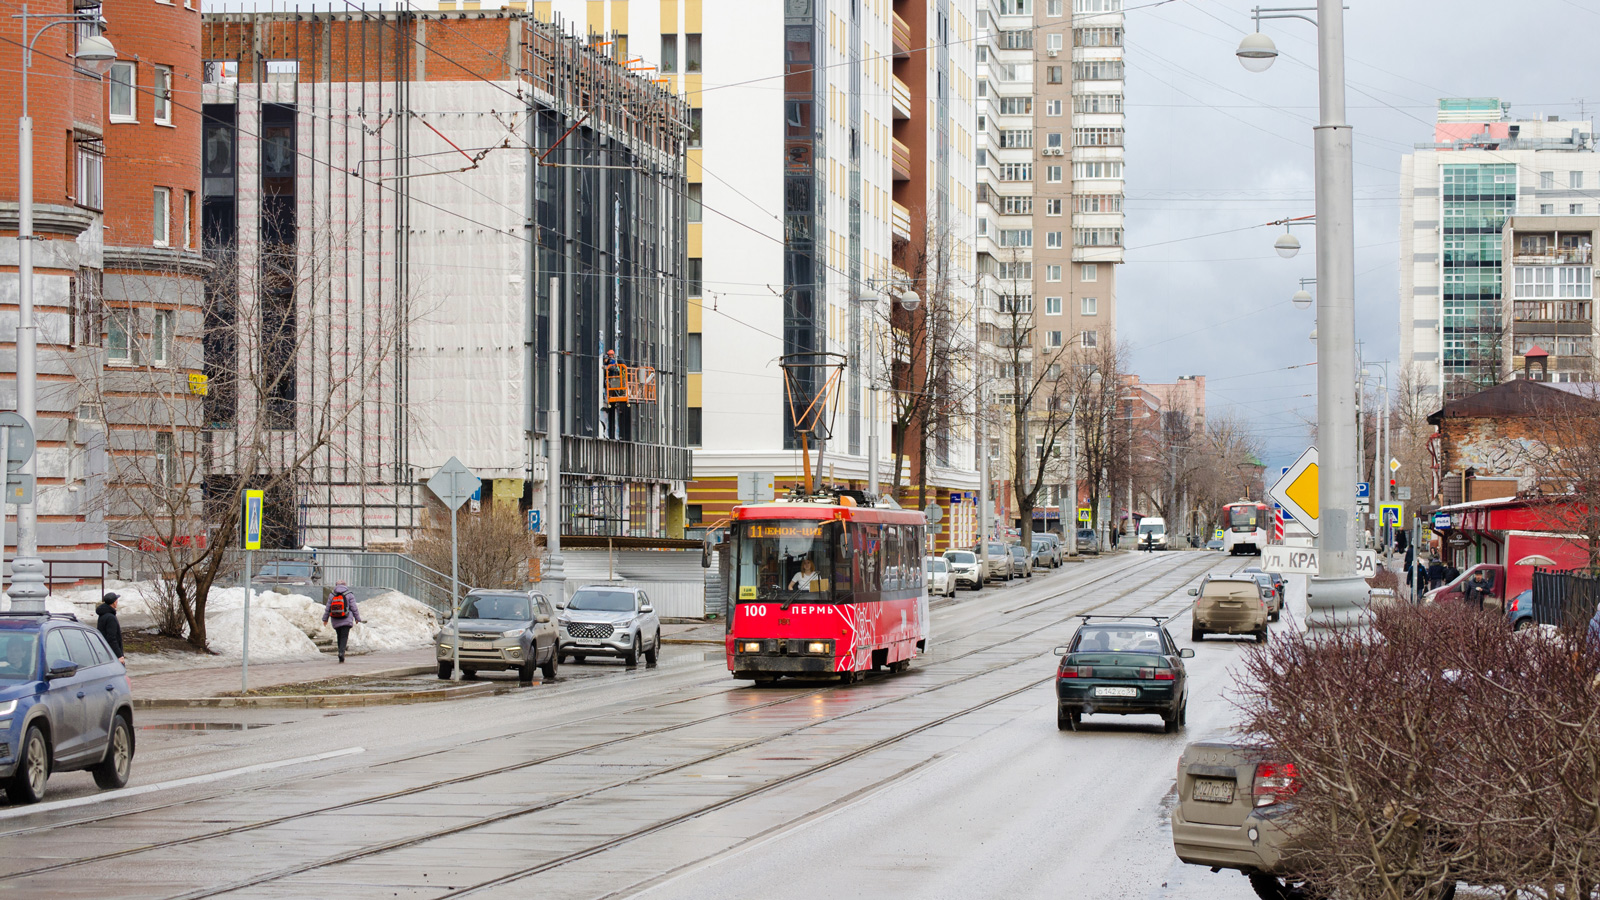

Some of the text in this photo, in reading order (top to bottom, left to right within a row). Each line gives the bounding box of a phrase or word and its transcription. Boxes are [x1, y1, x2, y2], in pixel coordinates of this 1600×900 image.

[750, 525, 763, 538] 11
[1262, 554, 1284, 570] ул.
[744, 605, 767, 616] 100
[792, 606, 834, 614] ПЕРМЬ
